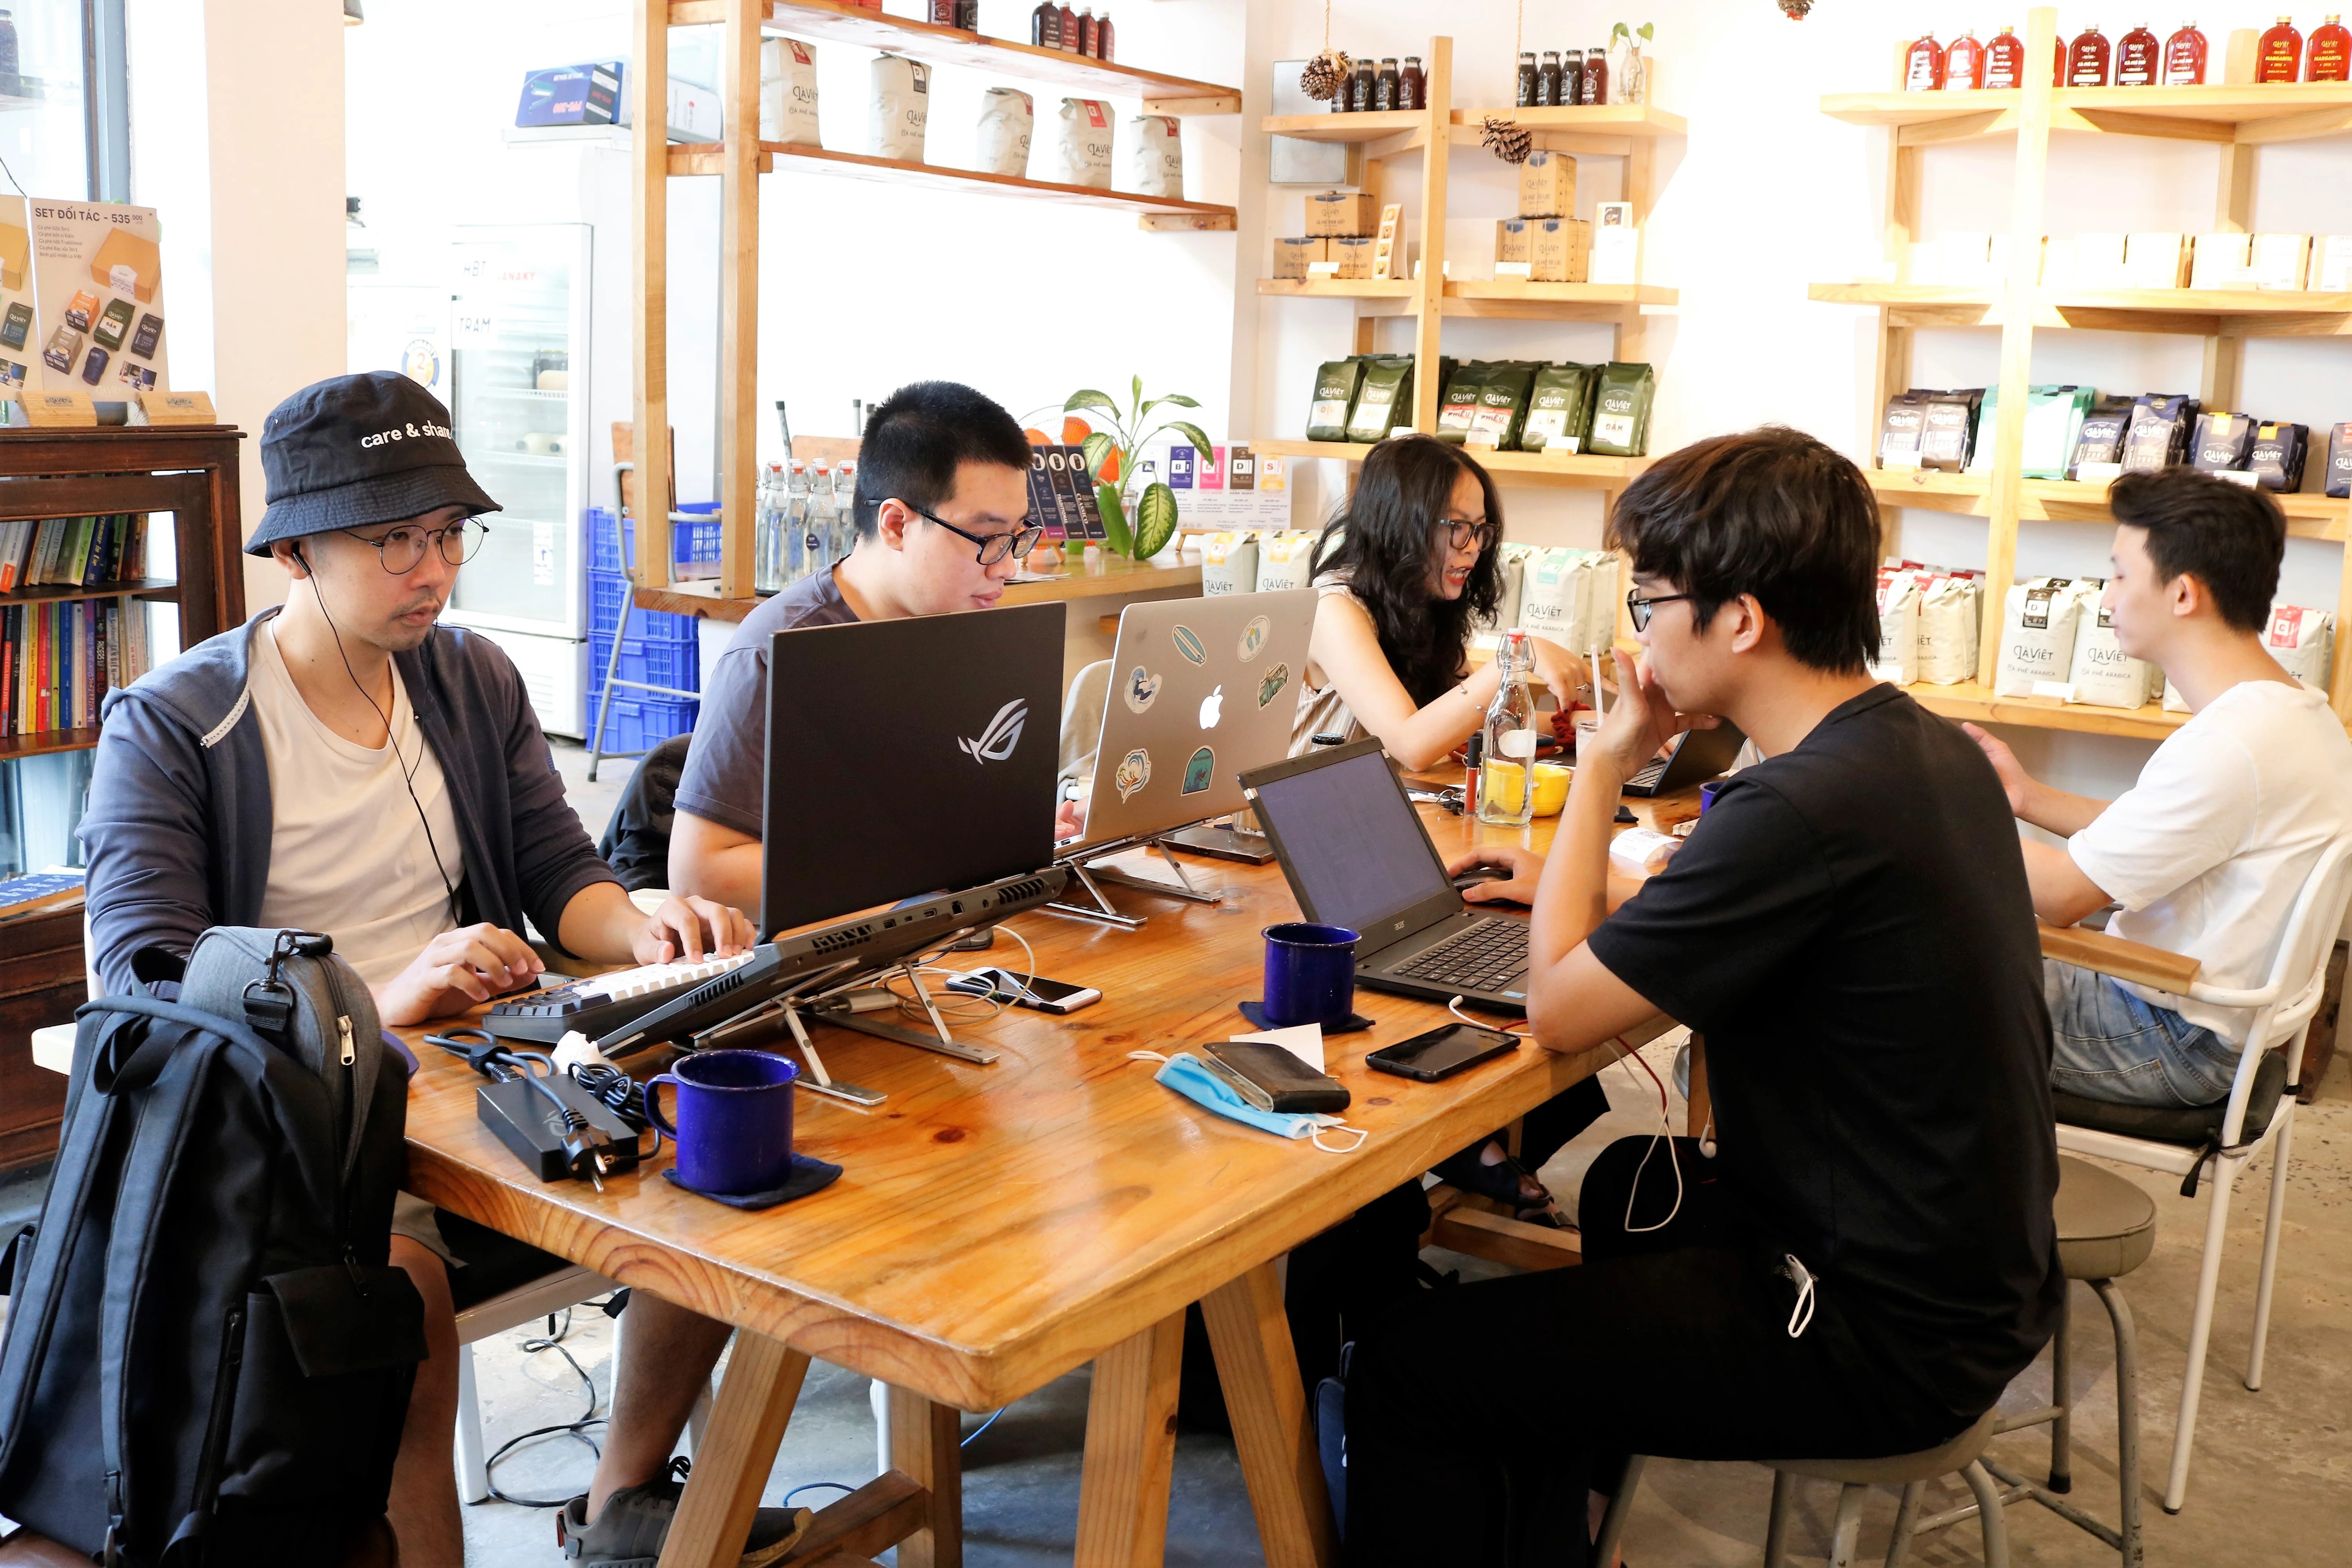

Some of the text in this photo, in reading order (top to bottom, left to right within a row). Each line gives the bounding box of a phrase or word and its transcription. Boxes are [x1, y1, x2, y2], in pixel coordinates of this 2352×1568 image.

[35, 208, 54, 218] SET
[57, 206, 76, 219] ĐỐI
[79, 209, 100, 221] TÁC
[498, 272, 535, 281] ANAKY
[361, 420, 451, 448] care & share
[1056, 494, 1068, 524] TRADITIONAL
[1918, 635, 1931, 647] IỆT
[1394, 920, 1405, 930] acer
